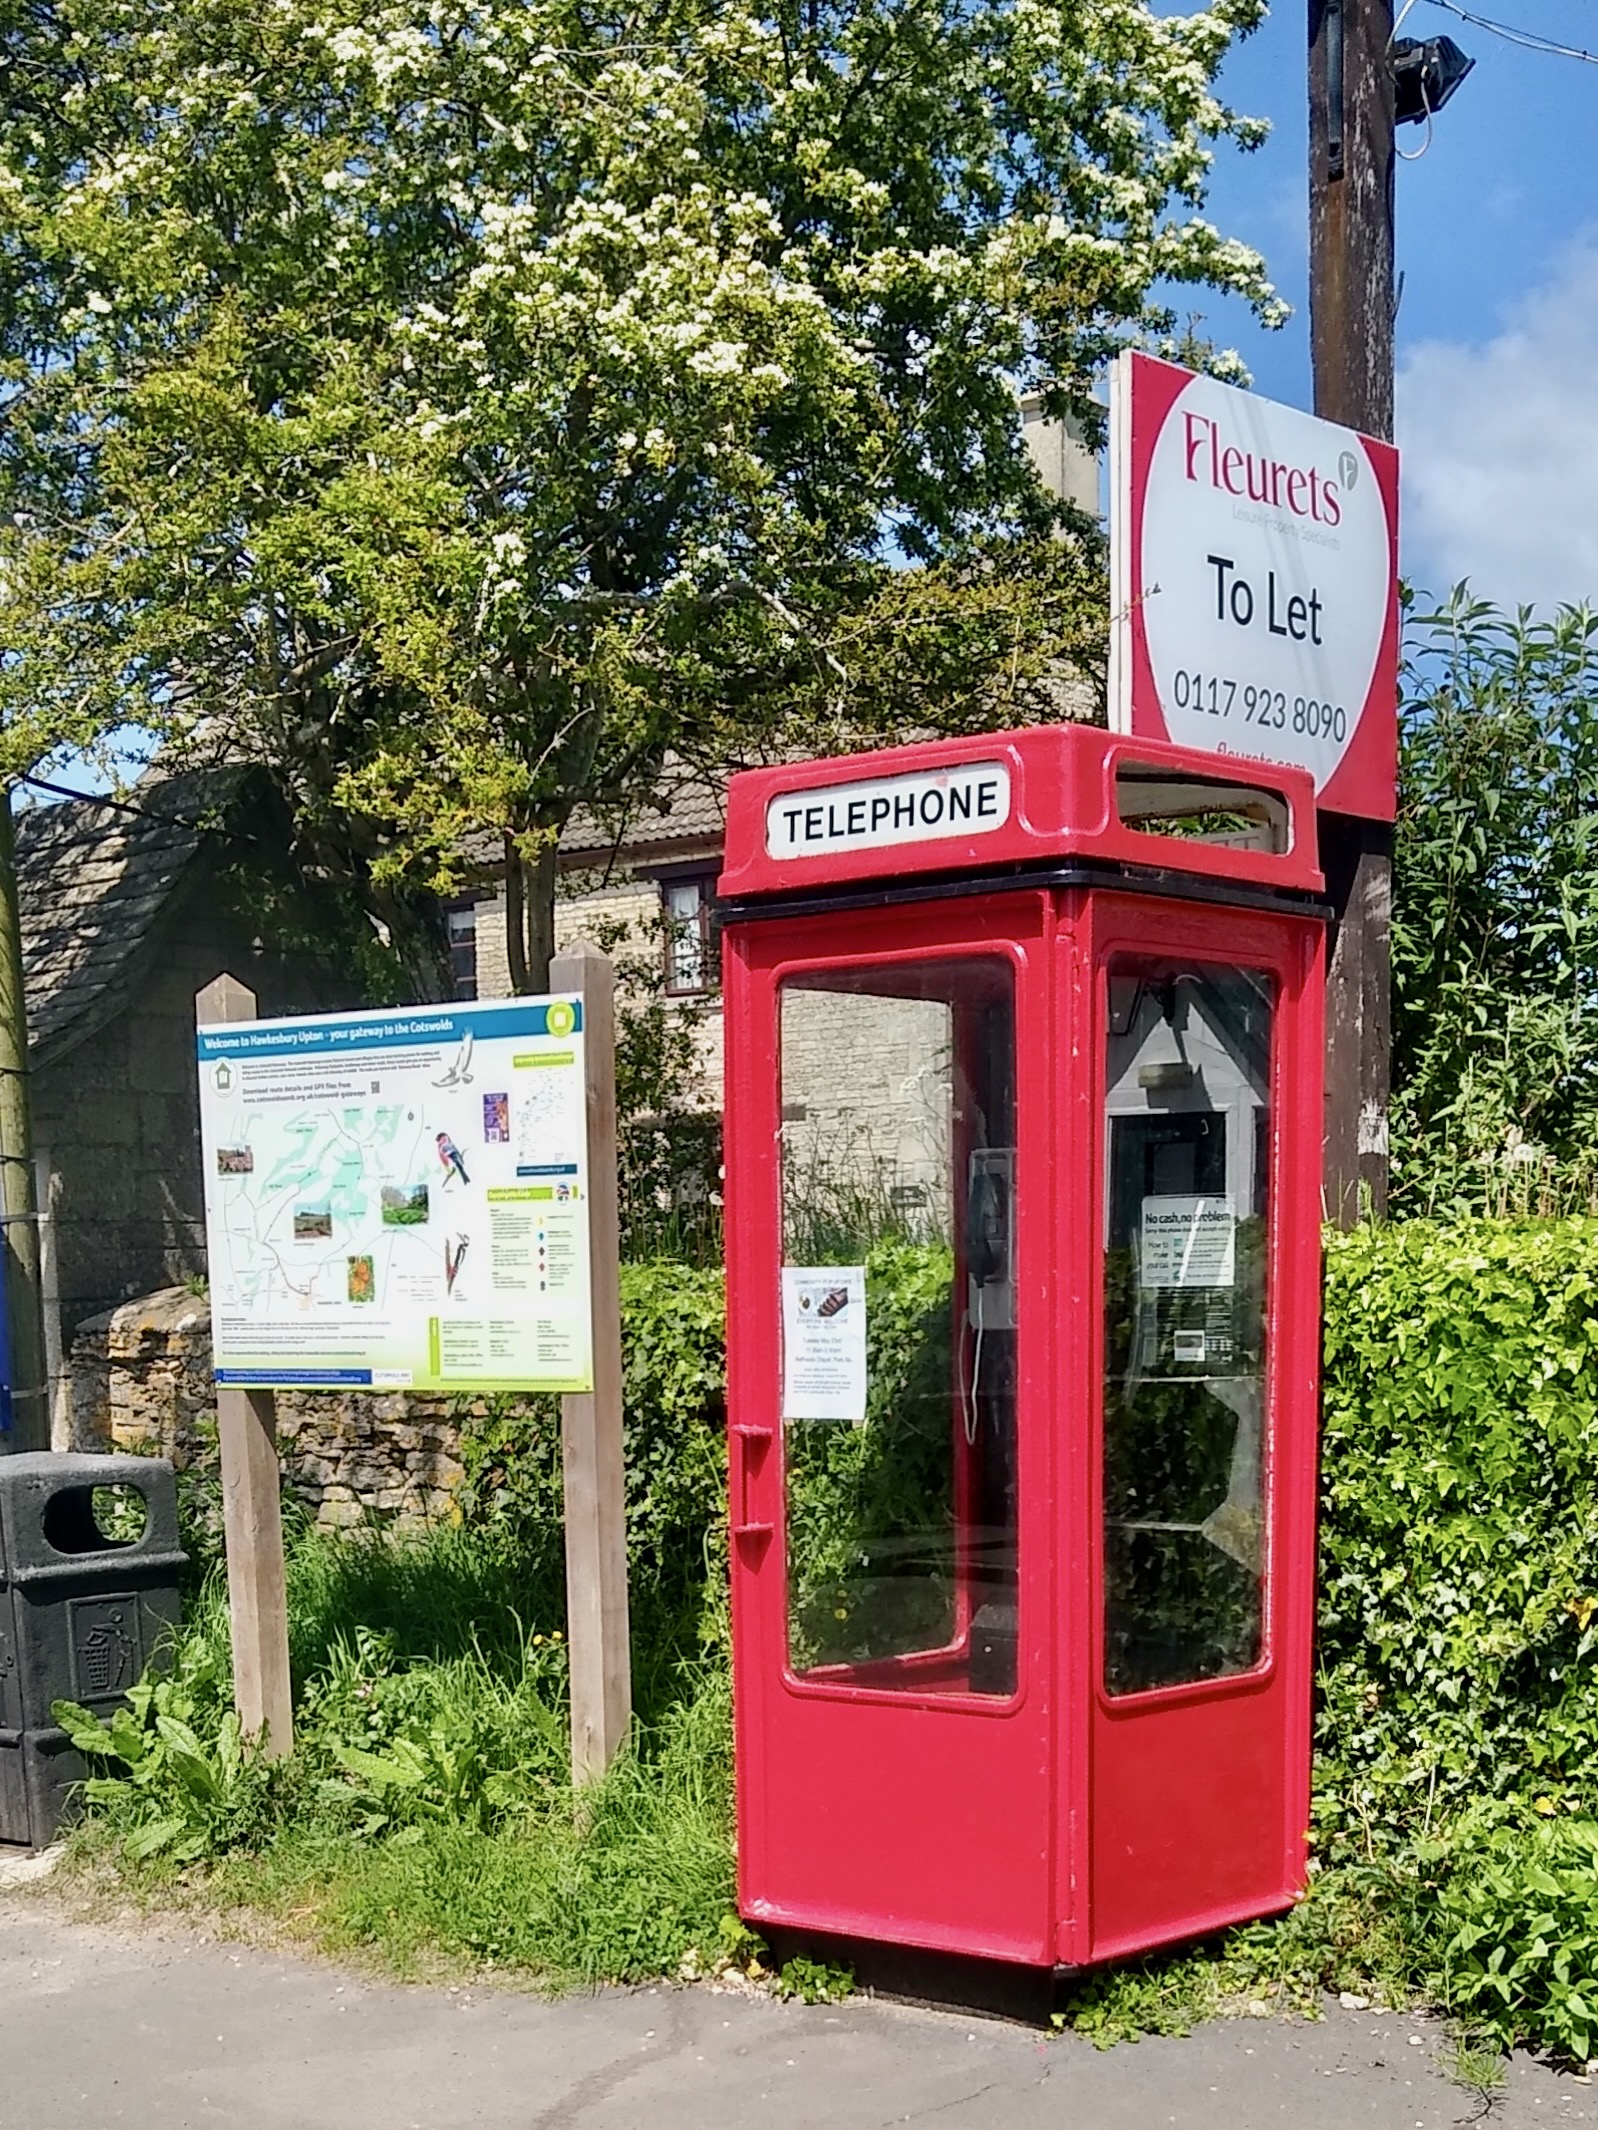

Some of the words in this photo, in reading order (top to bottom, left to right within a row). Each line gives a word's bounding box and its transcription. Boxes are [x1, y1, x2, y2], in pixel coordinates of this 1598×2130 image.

[1181, 410, 1341, 526] Fleurets
[1207, 554, 1253, 626] To
[1269, 571, 1322, 645] Let
[1174, 670, 1237, 717] 0117
[1244, 685, 1286, 729] 923
[1293, 697, 1346, 743] 8090
[783, 781, 998, 843] TELEPHONE
[204, 1038, 240, 1050] Welcome
[240, 1037, 250, 1046] to
[250, 1033, 297, 1046] Hawkesbury
[298, 1031, 324, 1044] Upton
[330, 1030, 349, 1042] your
[349, 1025, 384, 1040] gateway
[384, 1024, 394, 1035] to
[395, 1022, 409, 1034] the
[409, 1019, 453, 1033] Cotswolds
[1145, 1212, 1158, 1224] No
[1181, 1214, 1192, 1223] no
[1193, 1210, 1230, 1223] problem
